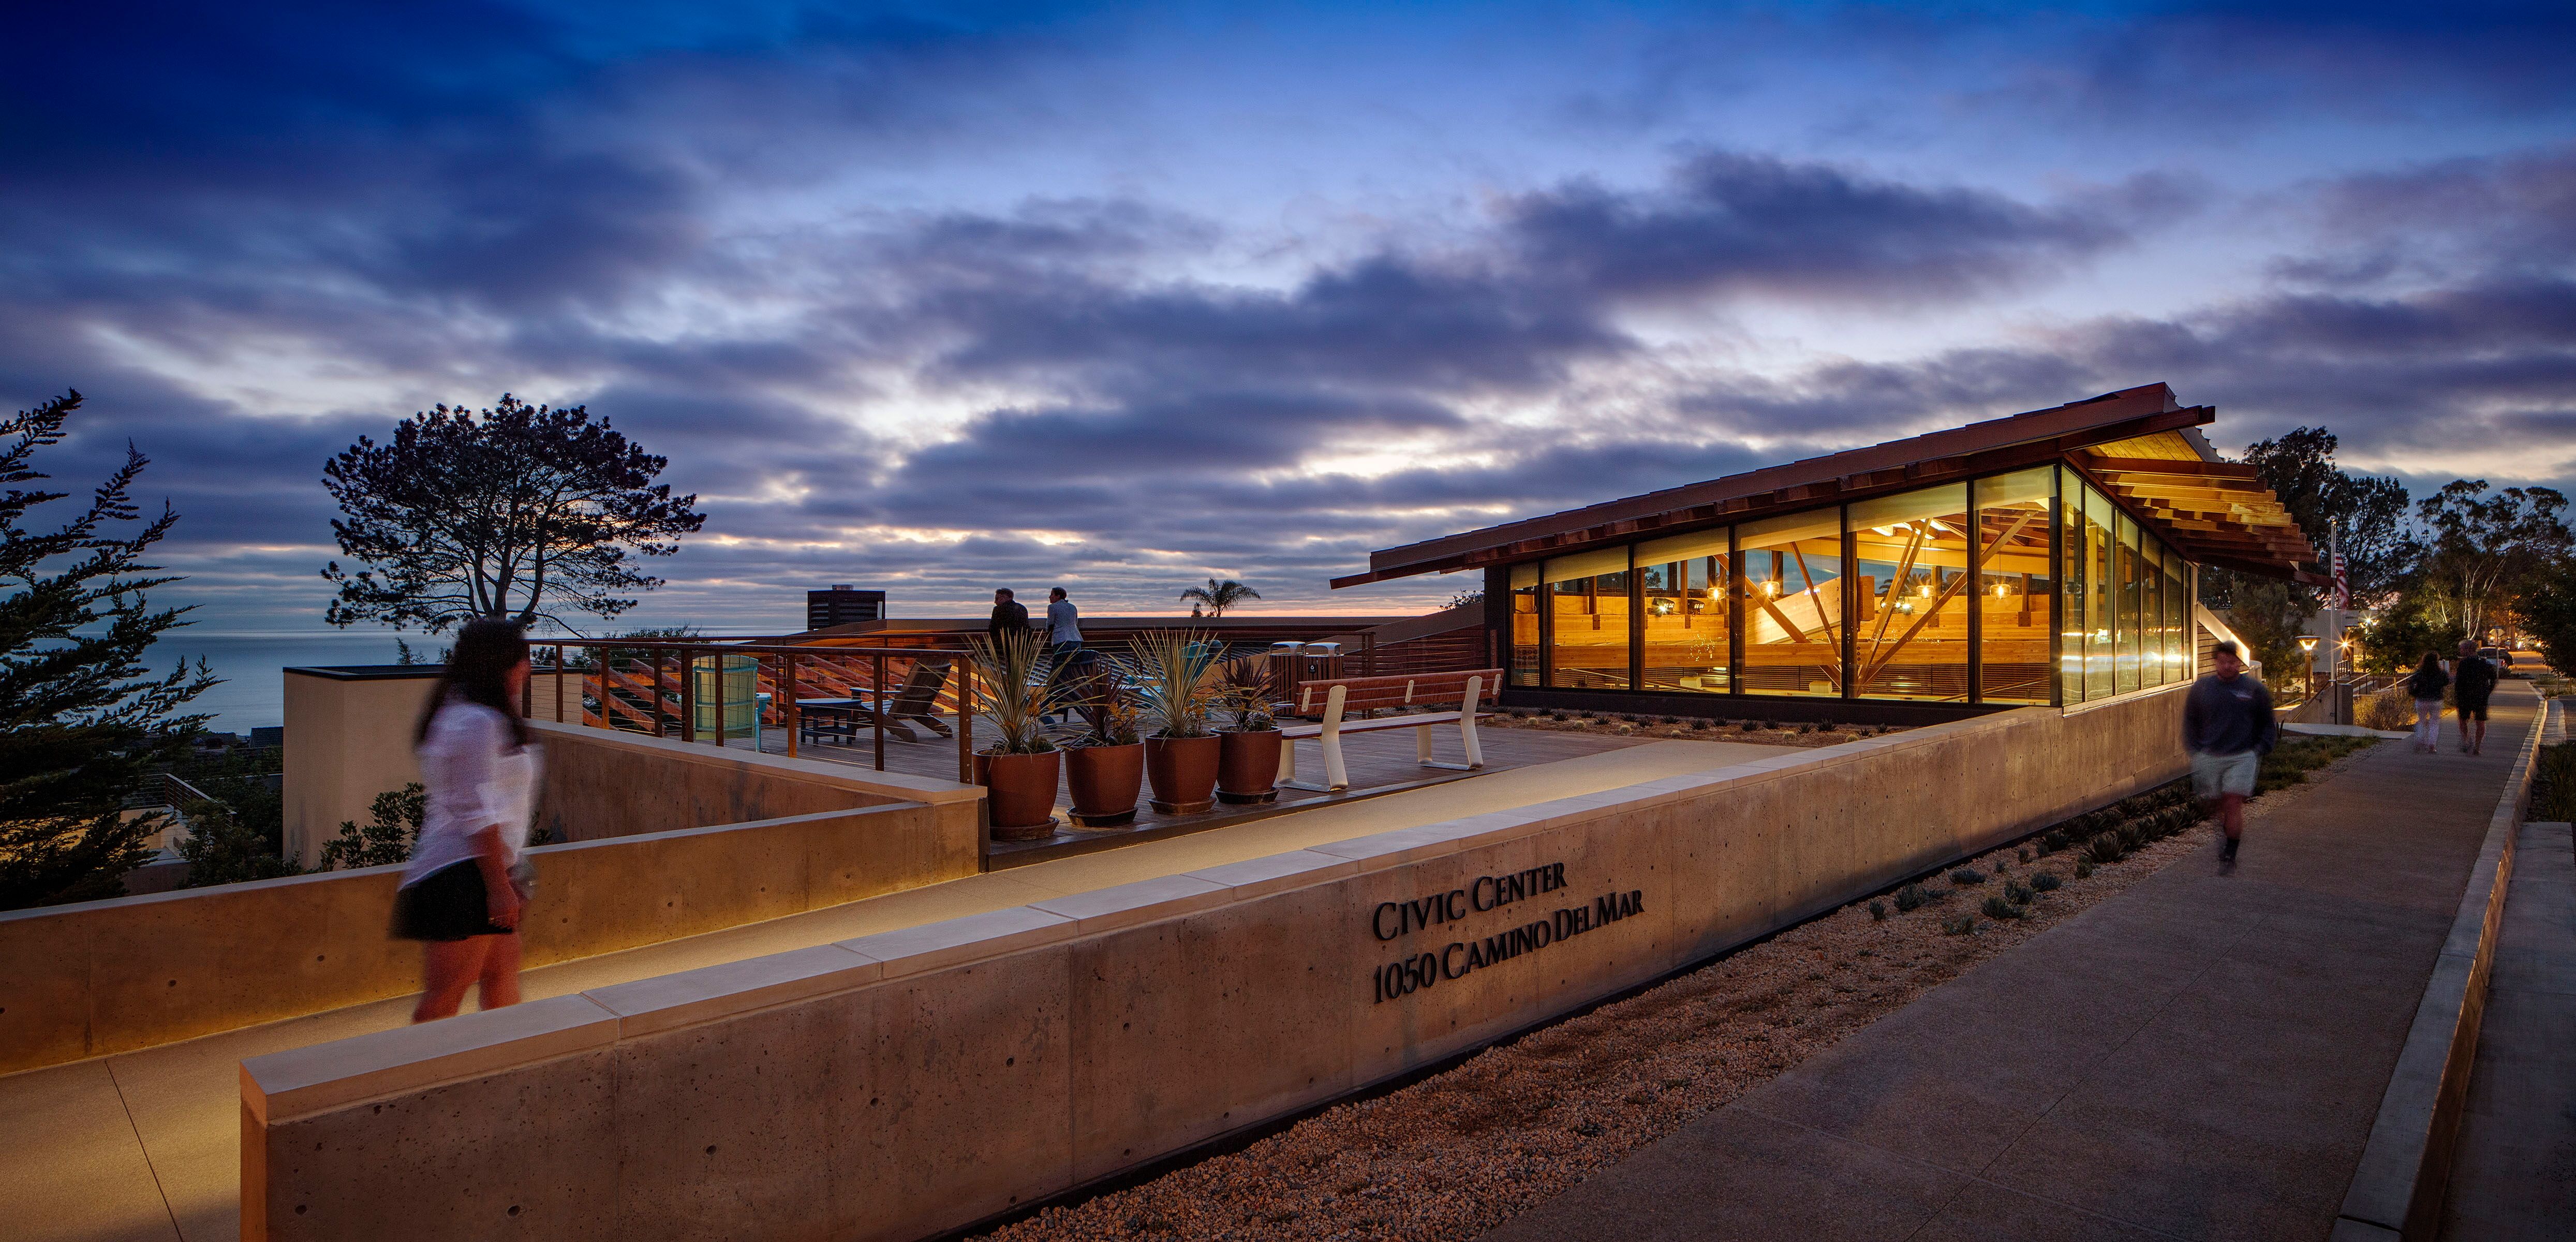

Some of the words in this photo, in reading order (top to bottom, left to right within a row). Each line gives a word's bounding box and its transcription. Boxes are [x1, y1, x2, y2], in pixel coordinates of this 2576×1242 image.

[1372, 890, 1466, 941] CIVIC
[1472, 862, 1568, 912] CENTER
[1373, 953, 1437, 1004] 1050
[1442, 920, 1551, 980] CAMINO
